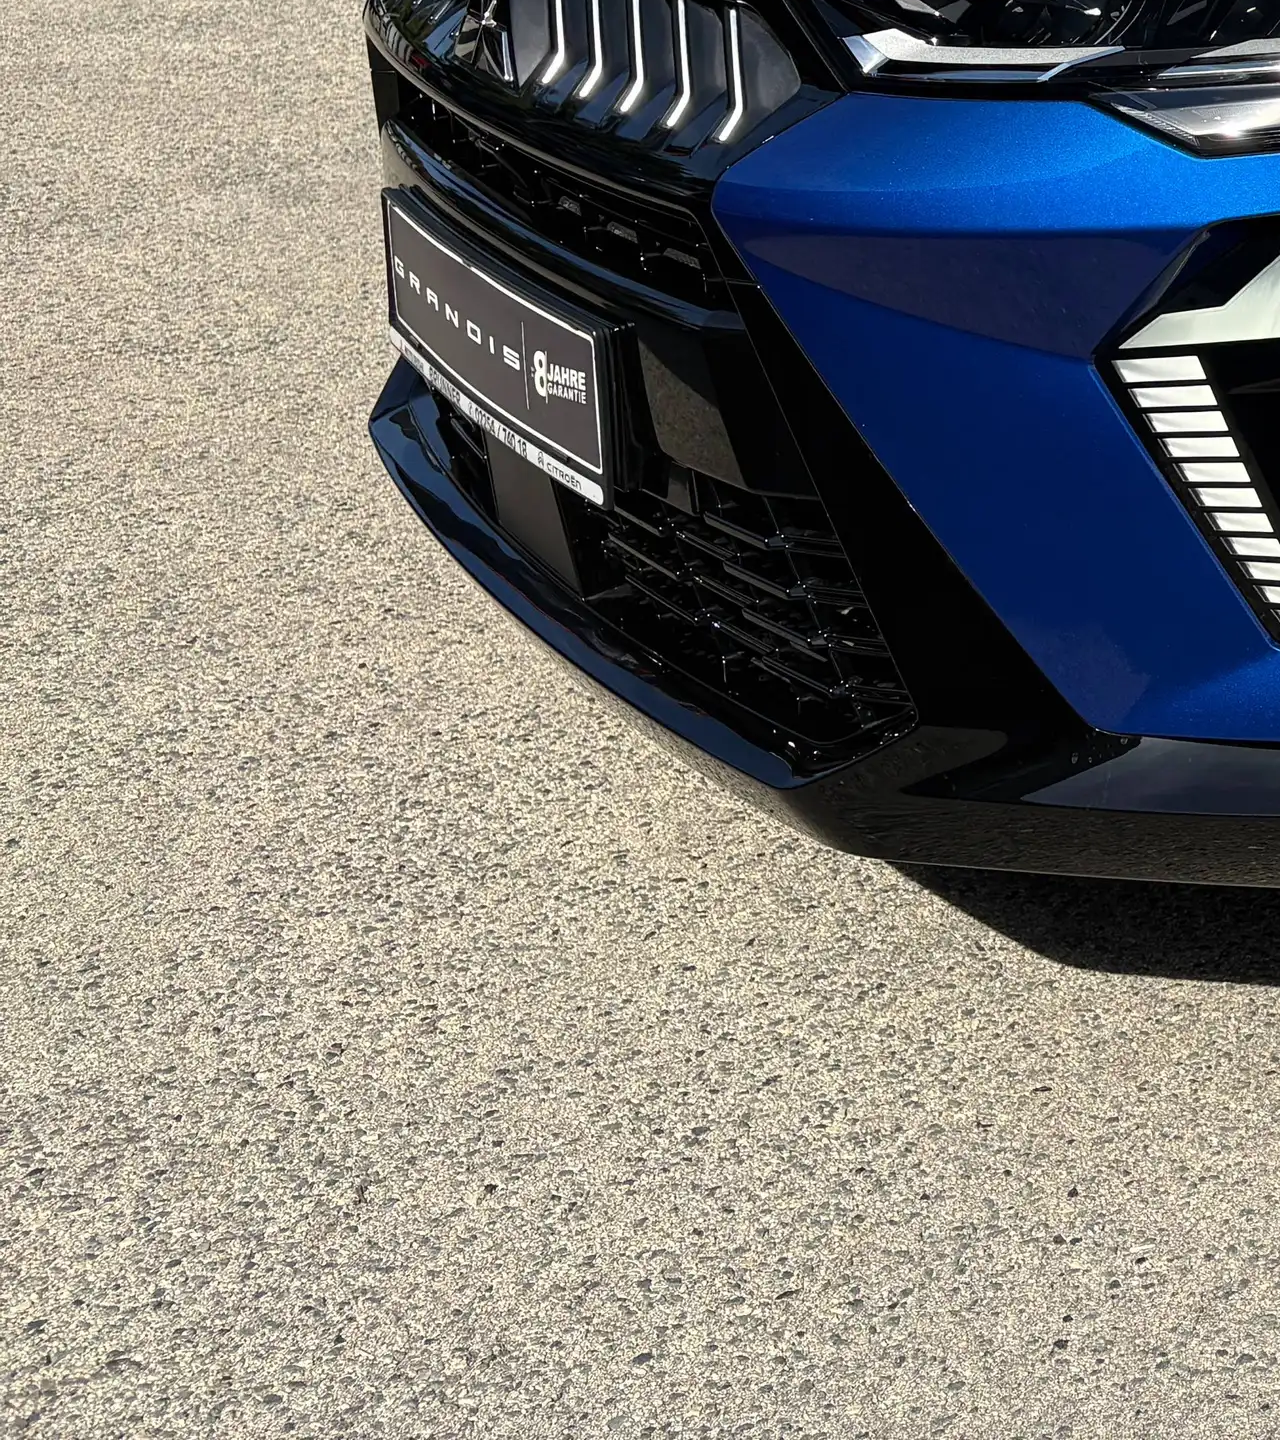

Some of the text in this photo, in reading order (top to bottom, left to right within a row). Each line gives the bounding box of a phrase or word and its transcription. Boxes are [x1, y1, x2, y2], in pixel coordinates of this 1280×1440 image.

[394, 255, 520, 371] GRANDIS
[533, 350, 587, 398] 8 JAHRE
[547, 382, 587, 405] GARANTIE
